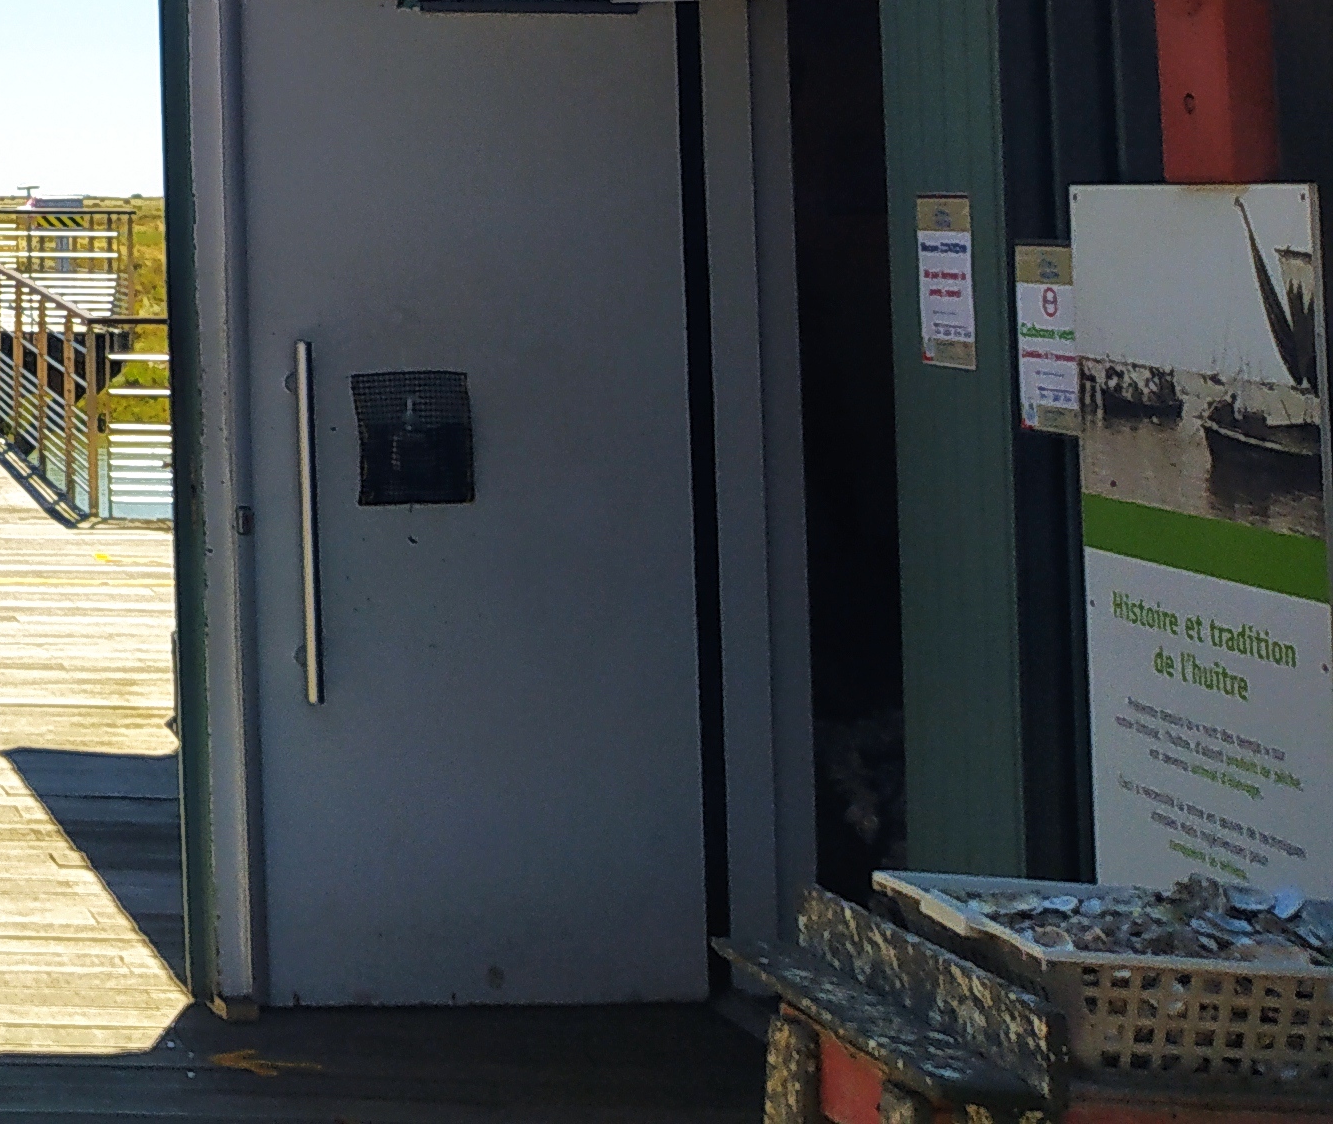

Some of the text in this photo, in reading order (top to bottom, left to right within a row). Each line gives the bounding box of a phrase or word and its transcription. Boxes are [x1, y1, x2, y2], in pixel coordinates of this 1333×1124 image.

[1112, 590, 1298, 669] Histoire et tradition
[1152, 645, 1249, 702] de l'huître
